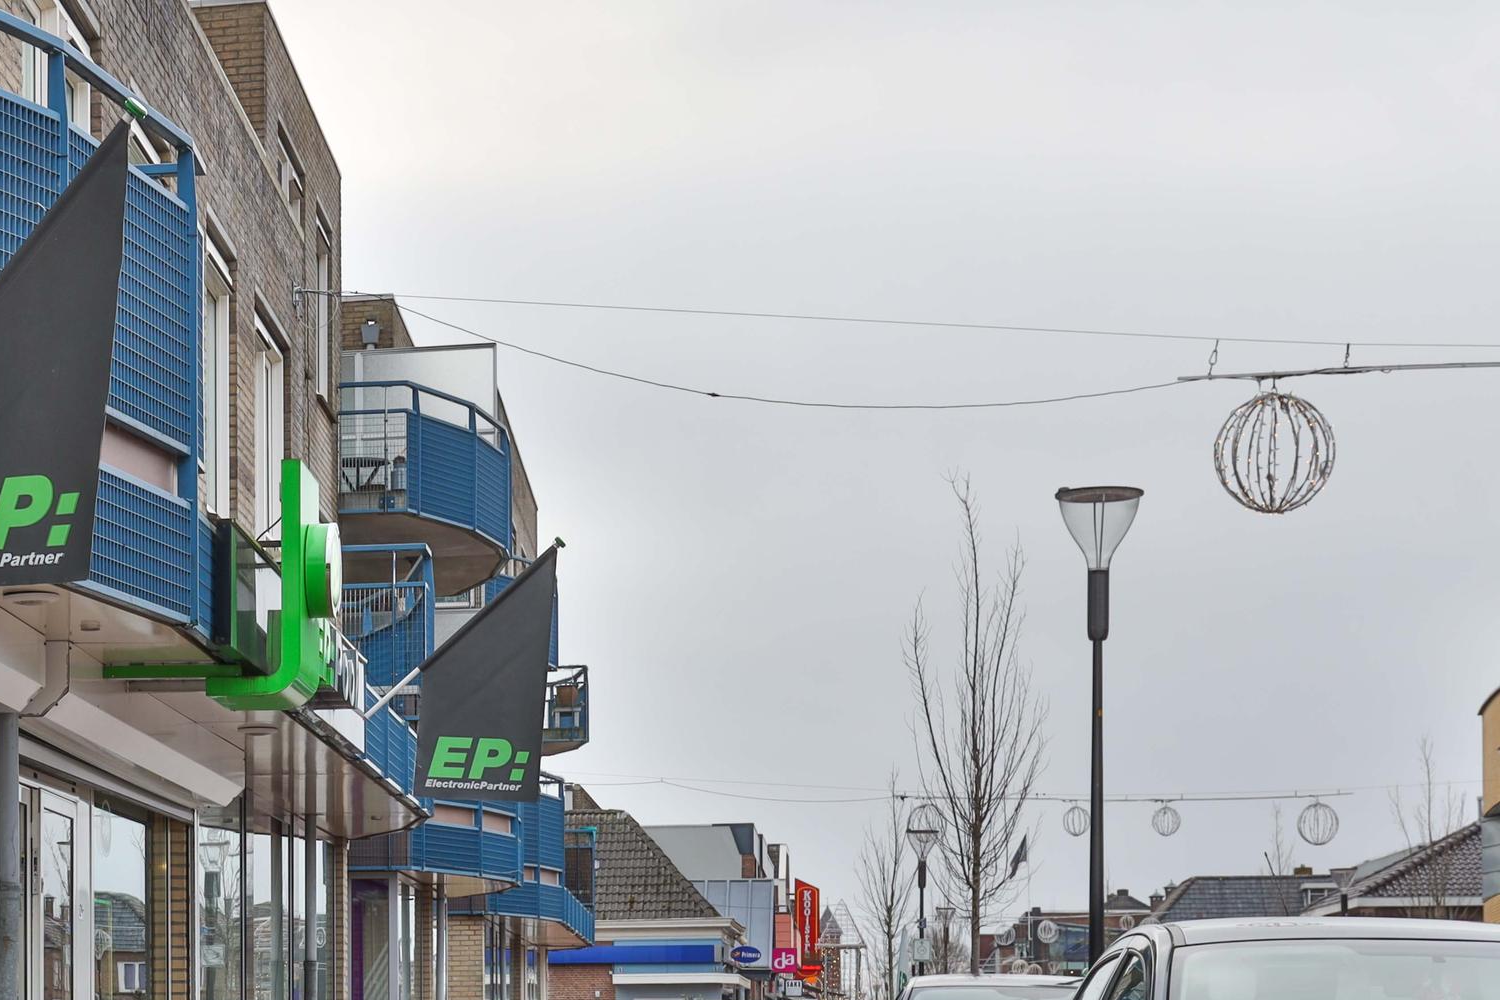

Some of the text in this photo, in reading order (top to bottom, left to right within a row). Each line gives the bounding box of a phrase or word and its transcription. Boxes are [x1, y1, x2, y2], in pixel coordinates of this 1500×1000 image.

[427, 736, 530, 781] EP:
[424, 778, 522, 792] ElectronicPartner
[741, 950, 761, 959] Primera
[773, 951, 795, 969] da
